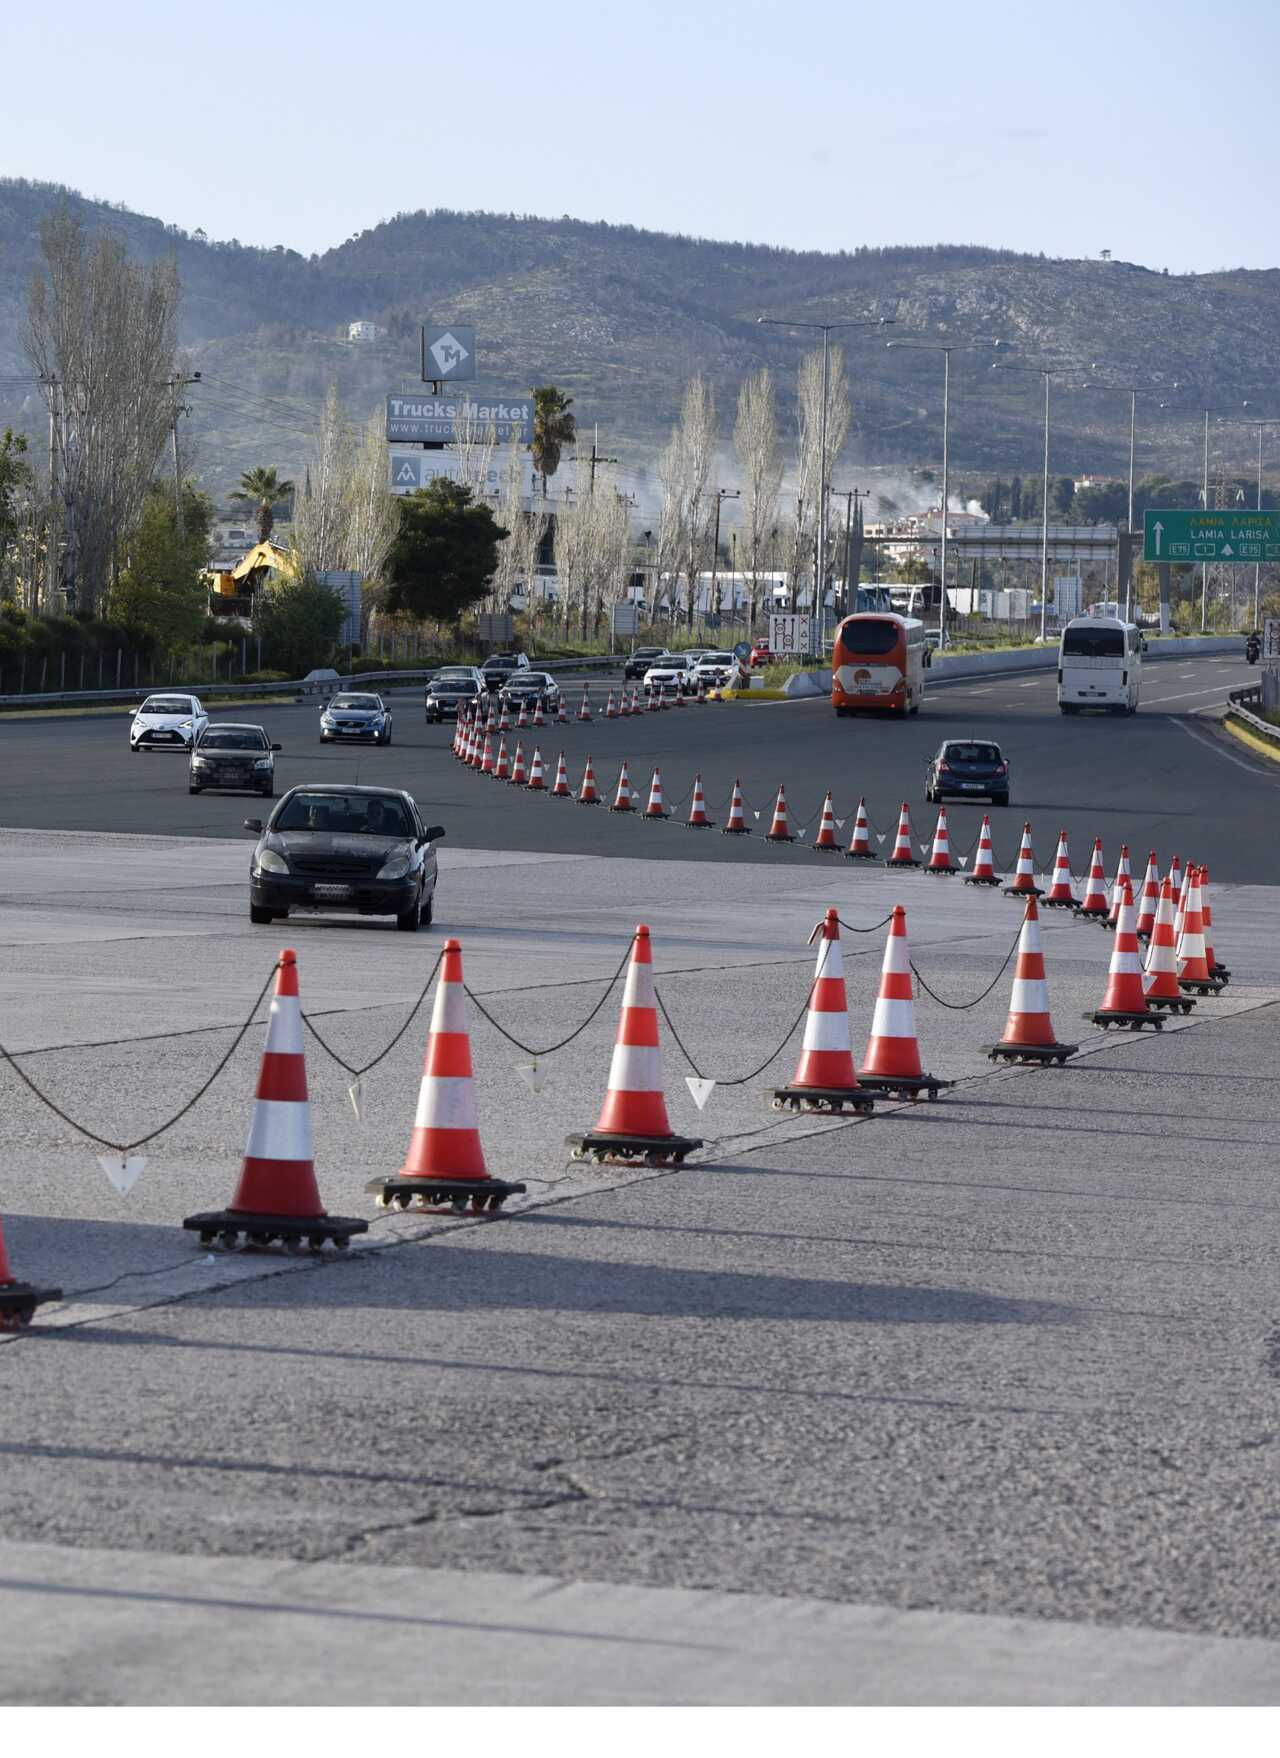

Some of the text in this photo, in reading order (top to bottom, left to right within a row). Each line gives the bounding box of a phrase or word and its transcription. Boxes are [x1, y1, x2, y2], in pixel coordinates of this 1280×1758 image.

[391, 399, 529, 420] Trucks Market
[1190, 529, 1270, 539] LAMIA LARISA
